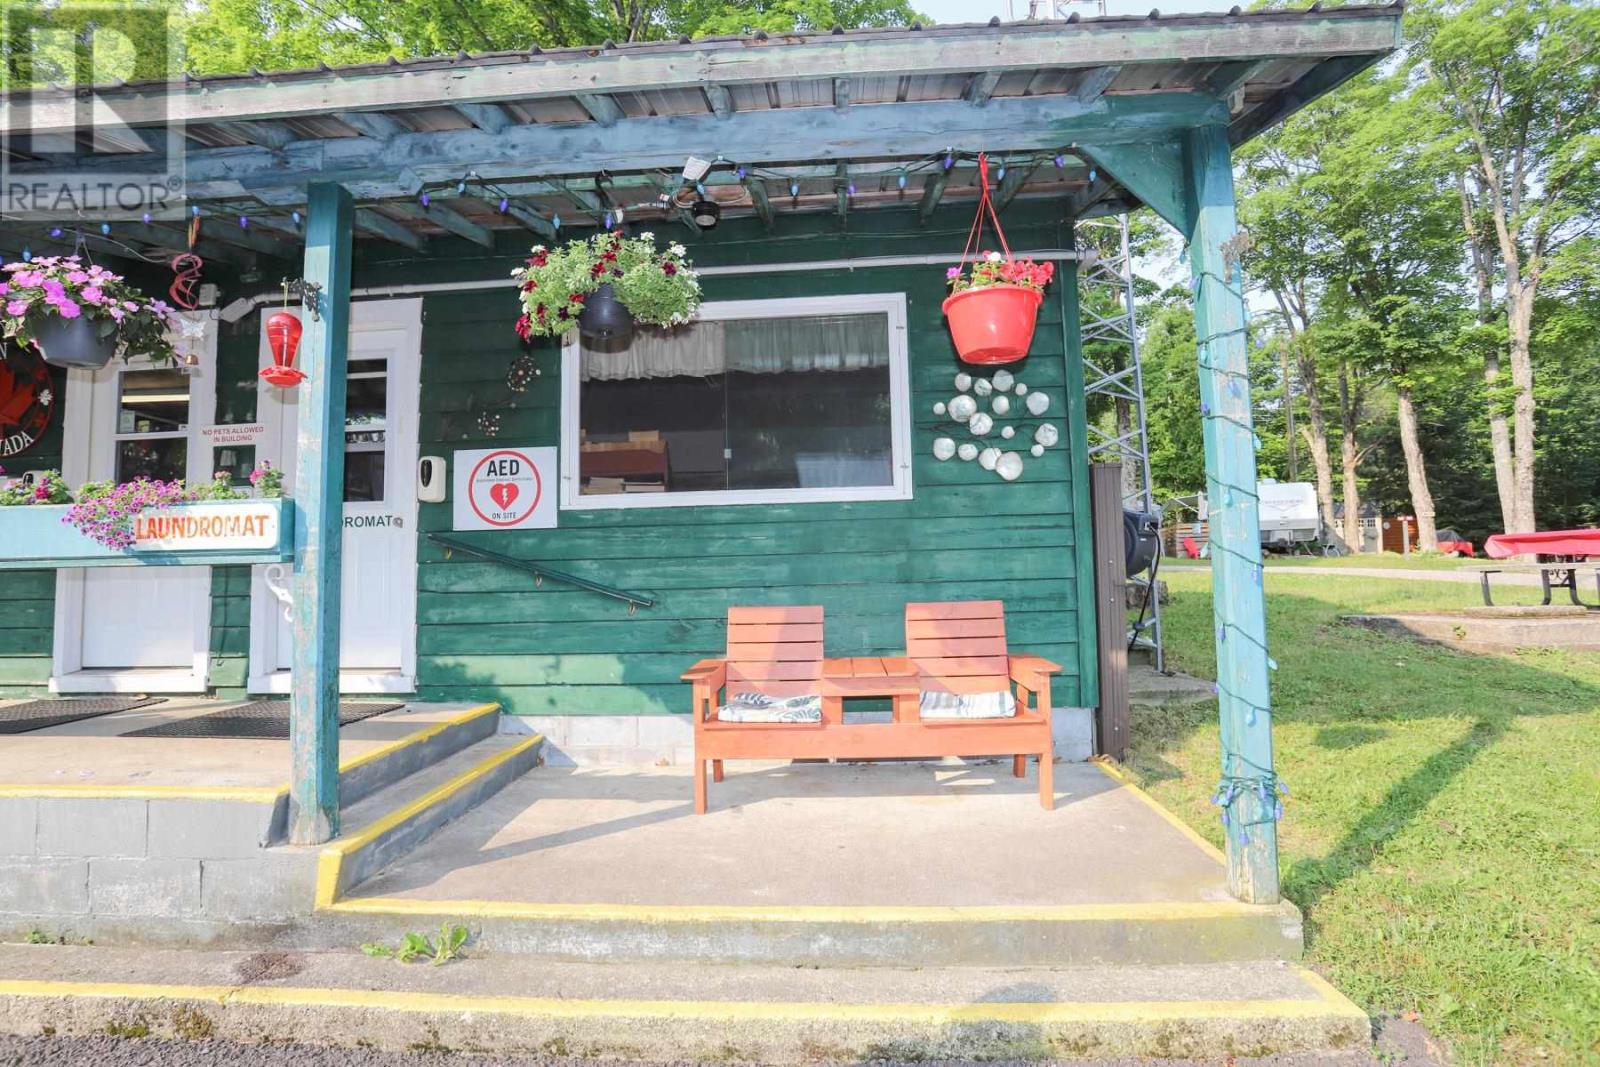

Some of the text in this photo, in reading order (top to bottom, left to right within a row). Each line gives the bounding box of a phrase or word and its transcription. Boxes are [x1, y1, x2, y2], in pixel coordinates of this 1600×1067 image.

[231, 426, 264, 434] ALLOWED
[486, 459, 520, 477] AED
[341, 515, 393, 528] ROMAT
[503, 511, 517, 519] SITE
[135, 515, 269, 540] LAUNDROMAT
